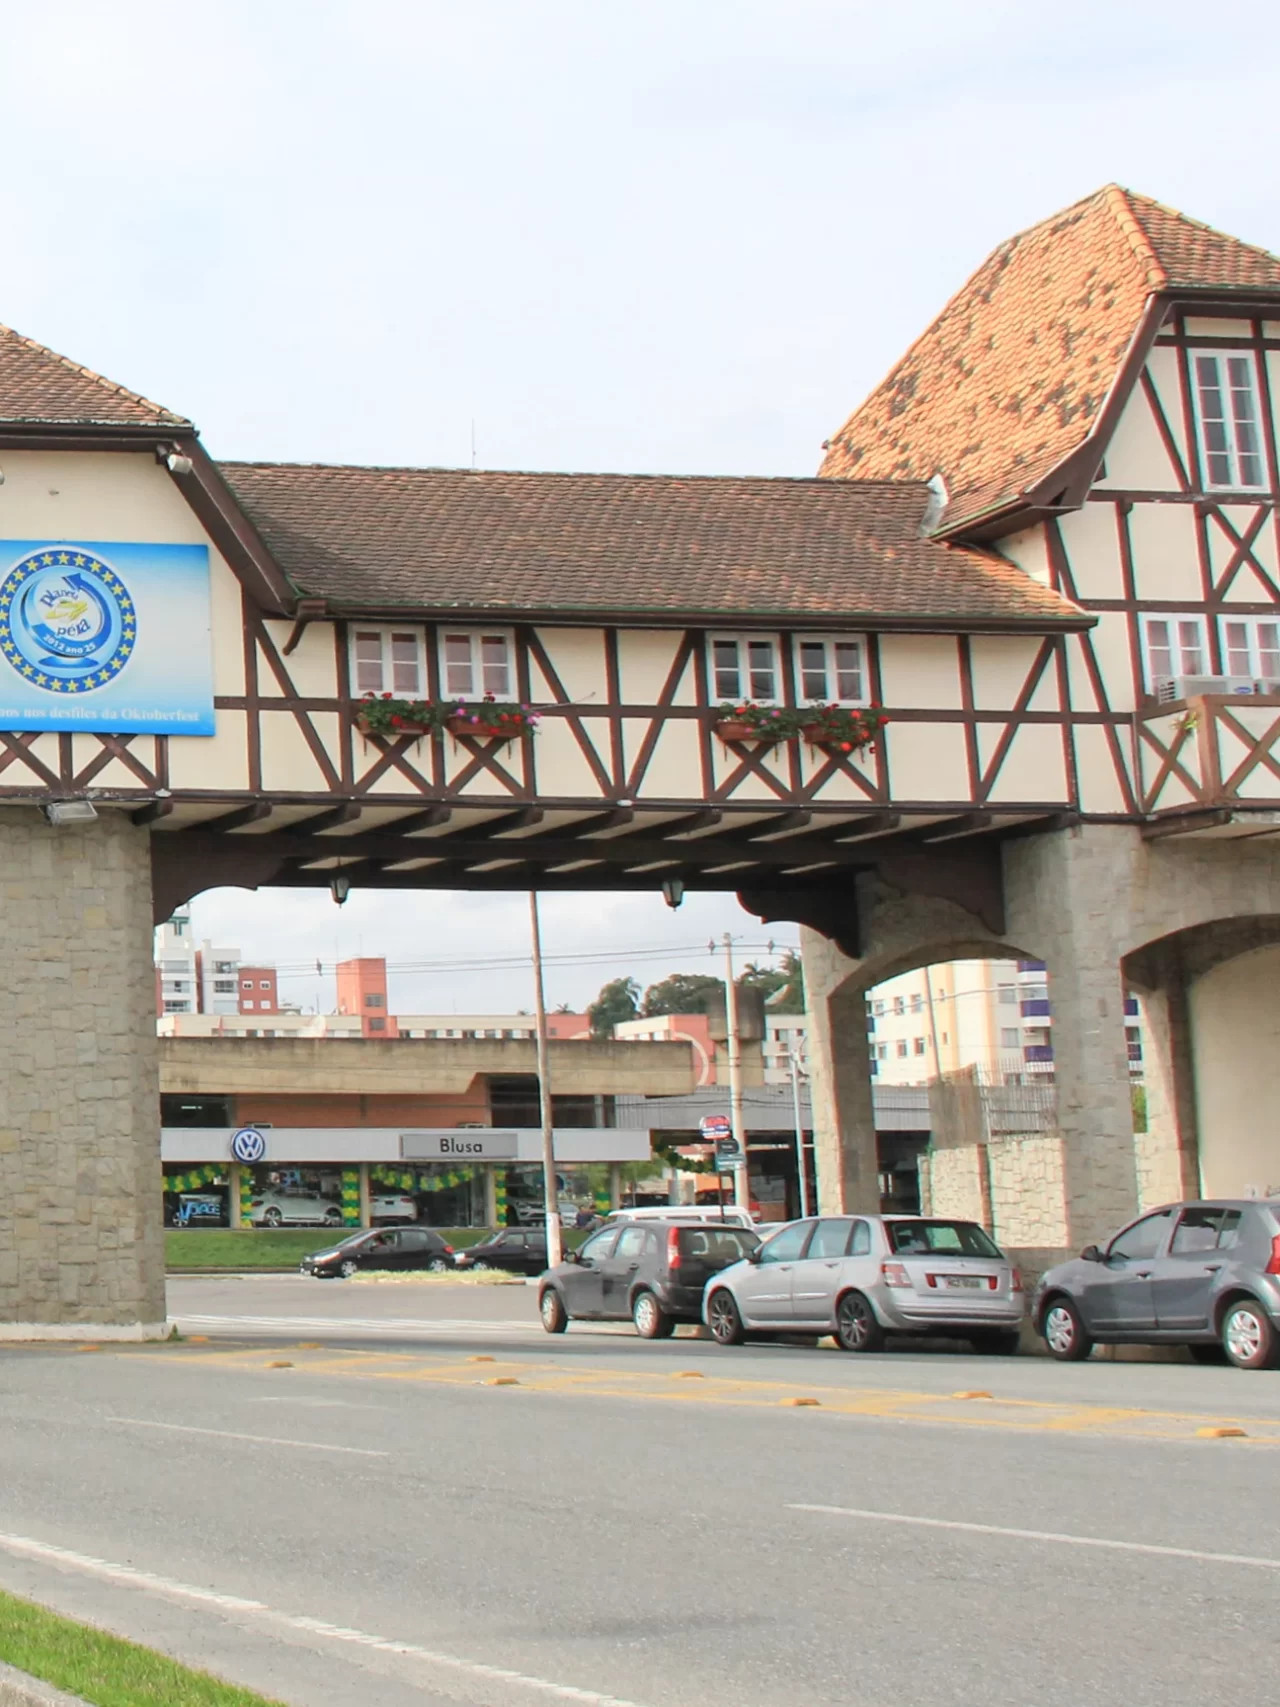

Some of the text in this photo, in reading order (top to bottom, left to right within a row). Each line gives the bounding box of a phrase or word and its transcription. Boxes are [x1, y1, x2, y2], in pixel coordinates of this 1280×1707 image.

[43, 634, 66, 651] 2012
[50, 706, 97, 719] desfiles
[121, 707, 200, 721] Oktoberfest
[439, 1137, 483, 1153] Blusa
